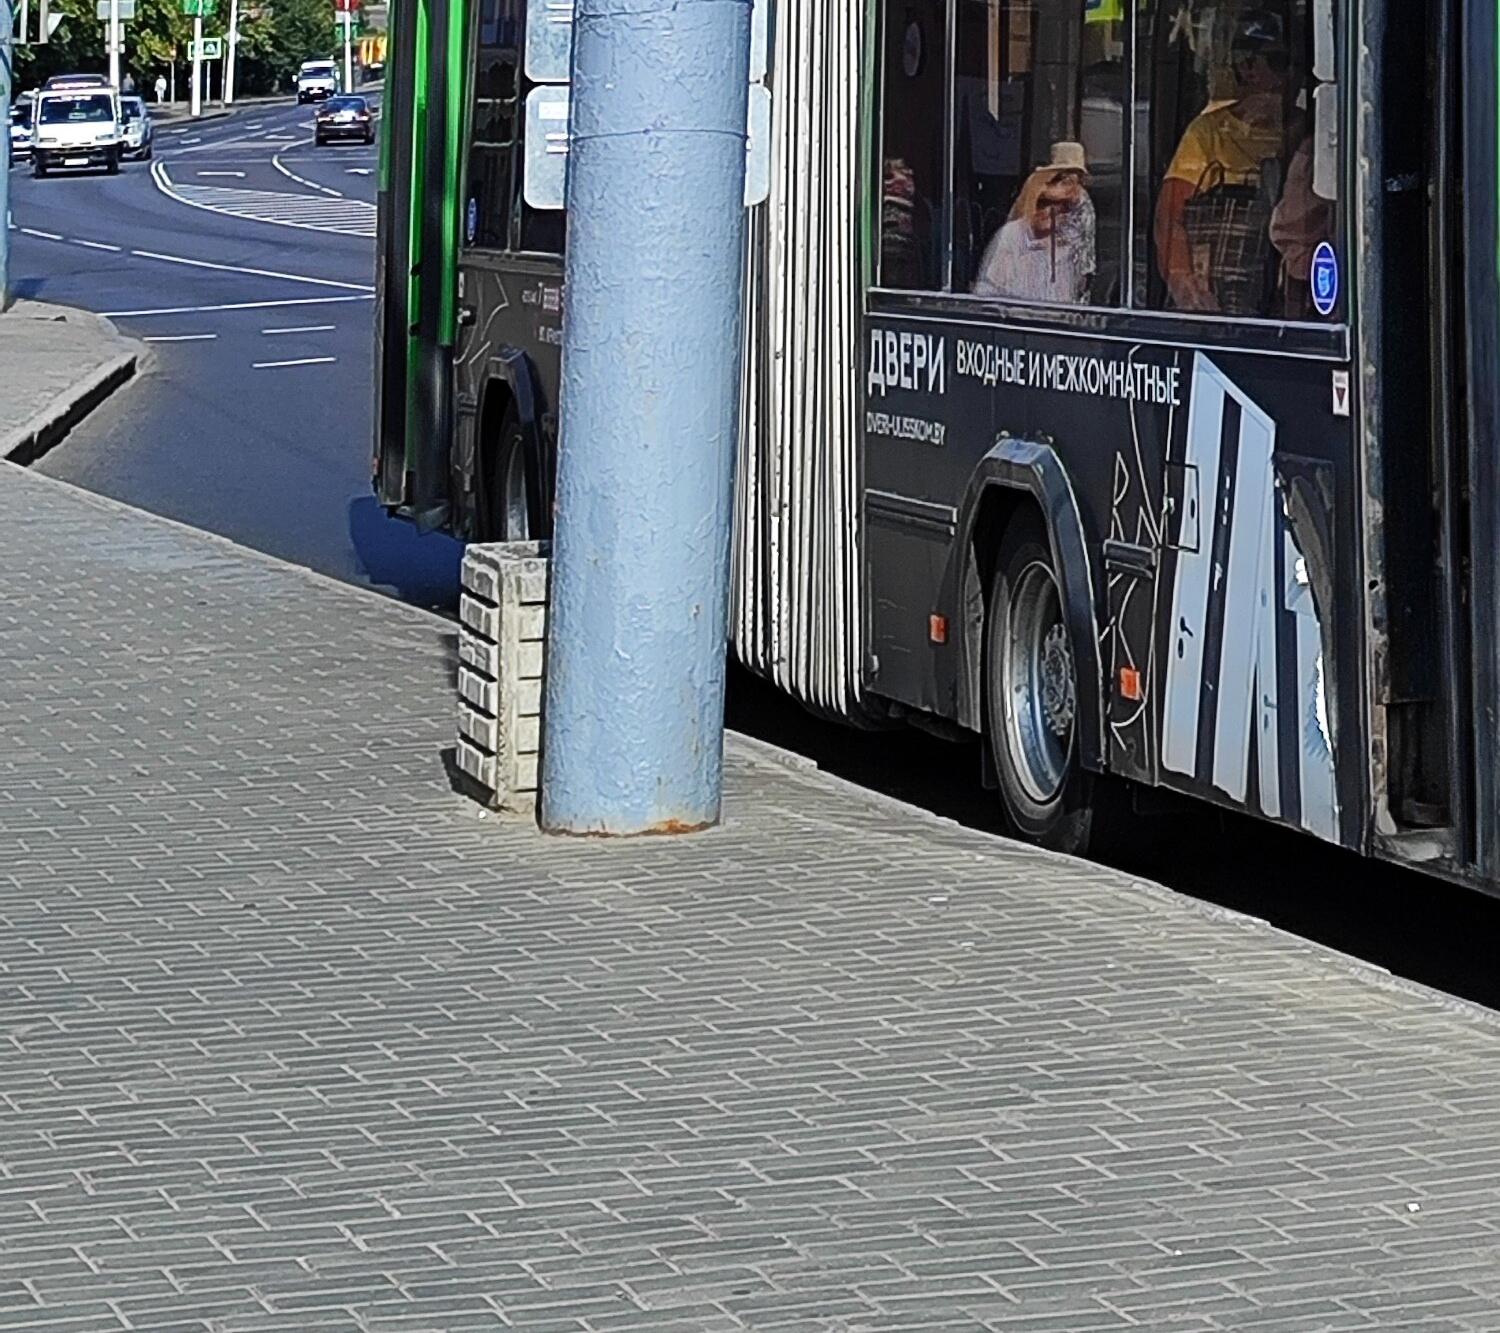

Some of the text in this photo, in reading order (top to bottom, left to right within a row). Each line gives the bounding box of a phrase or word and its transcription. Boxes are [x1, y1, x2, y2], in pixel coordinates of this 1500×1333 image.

[868, 329, 1181, 406] ДВЕРИ ВХОДНЫЕ И МЕЖКОМНАТНЫЕ
